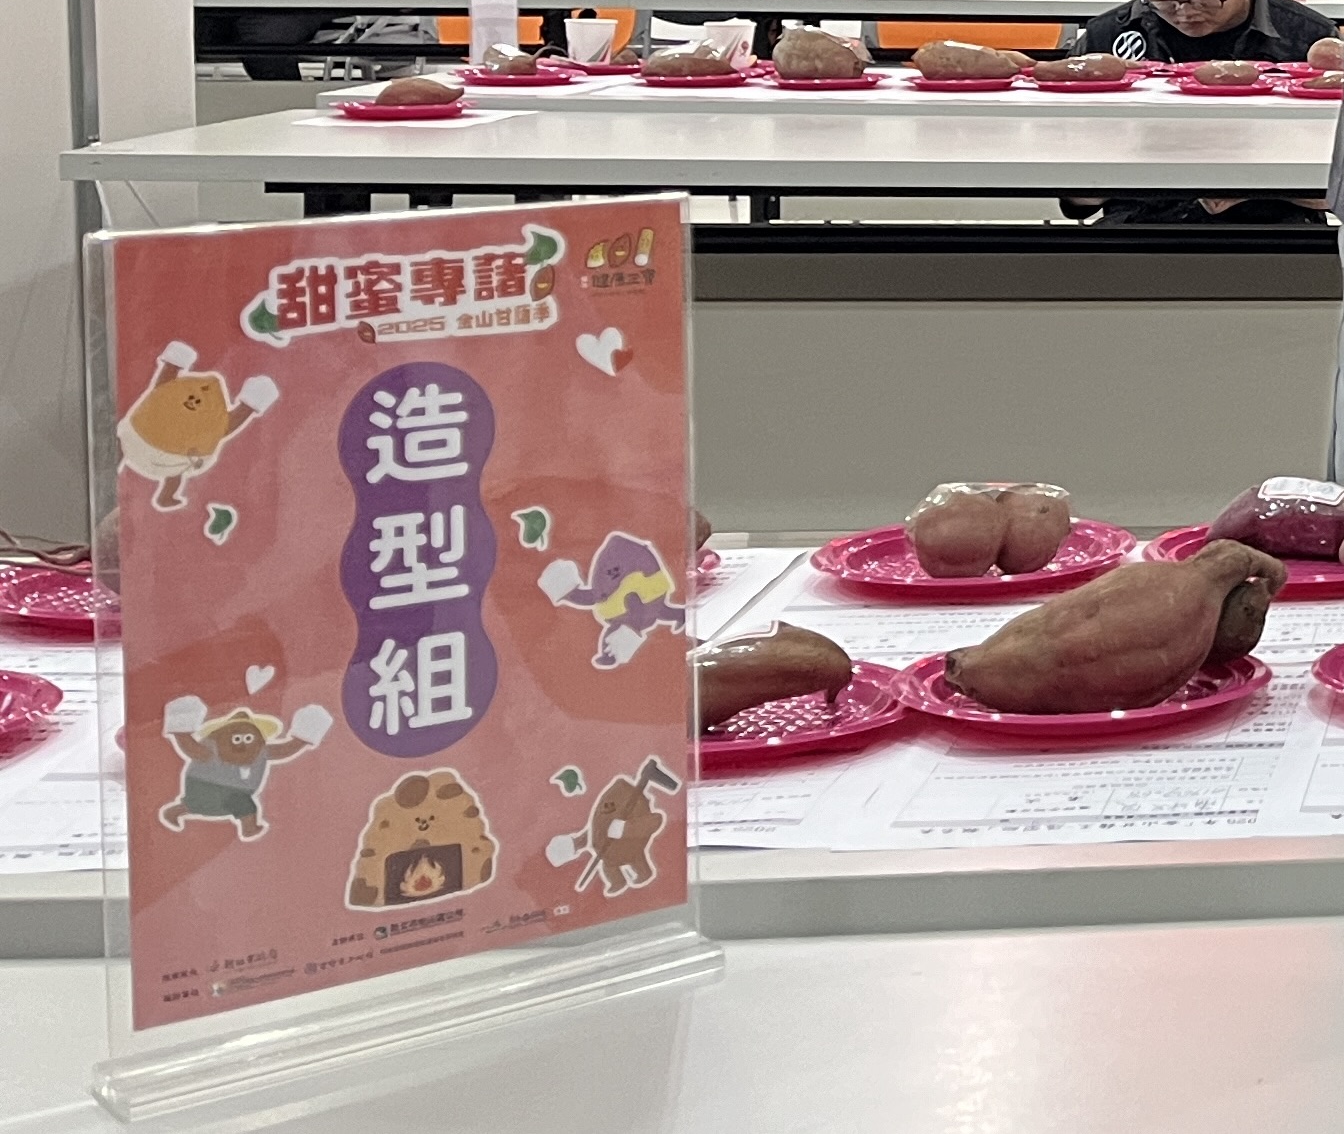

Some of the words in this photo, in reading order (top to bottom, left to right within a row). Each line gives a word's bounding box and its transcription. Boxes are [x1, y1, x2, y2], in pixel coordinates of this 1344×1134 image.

[377, 315, 447, 335] 2025
[365, 383, 474, 736] 造型組
